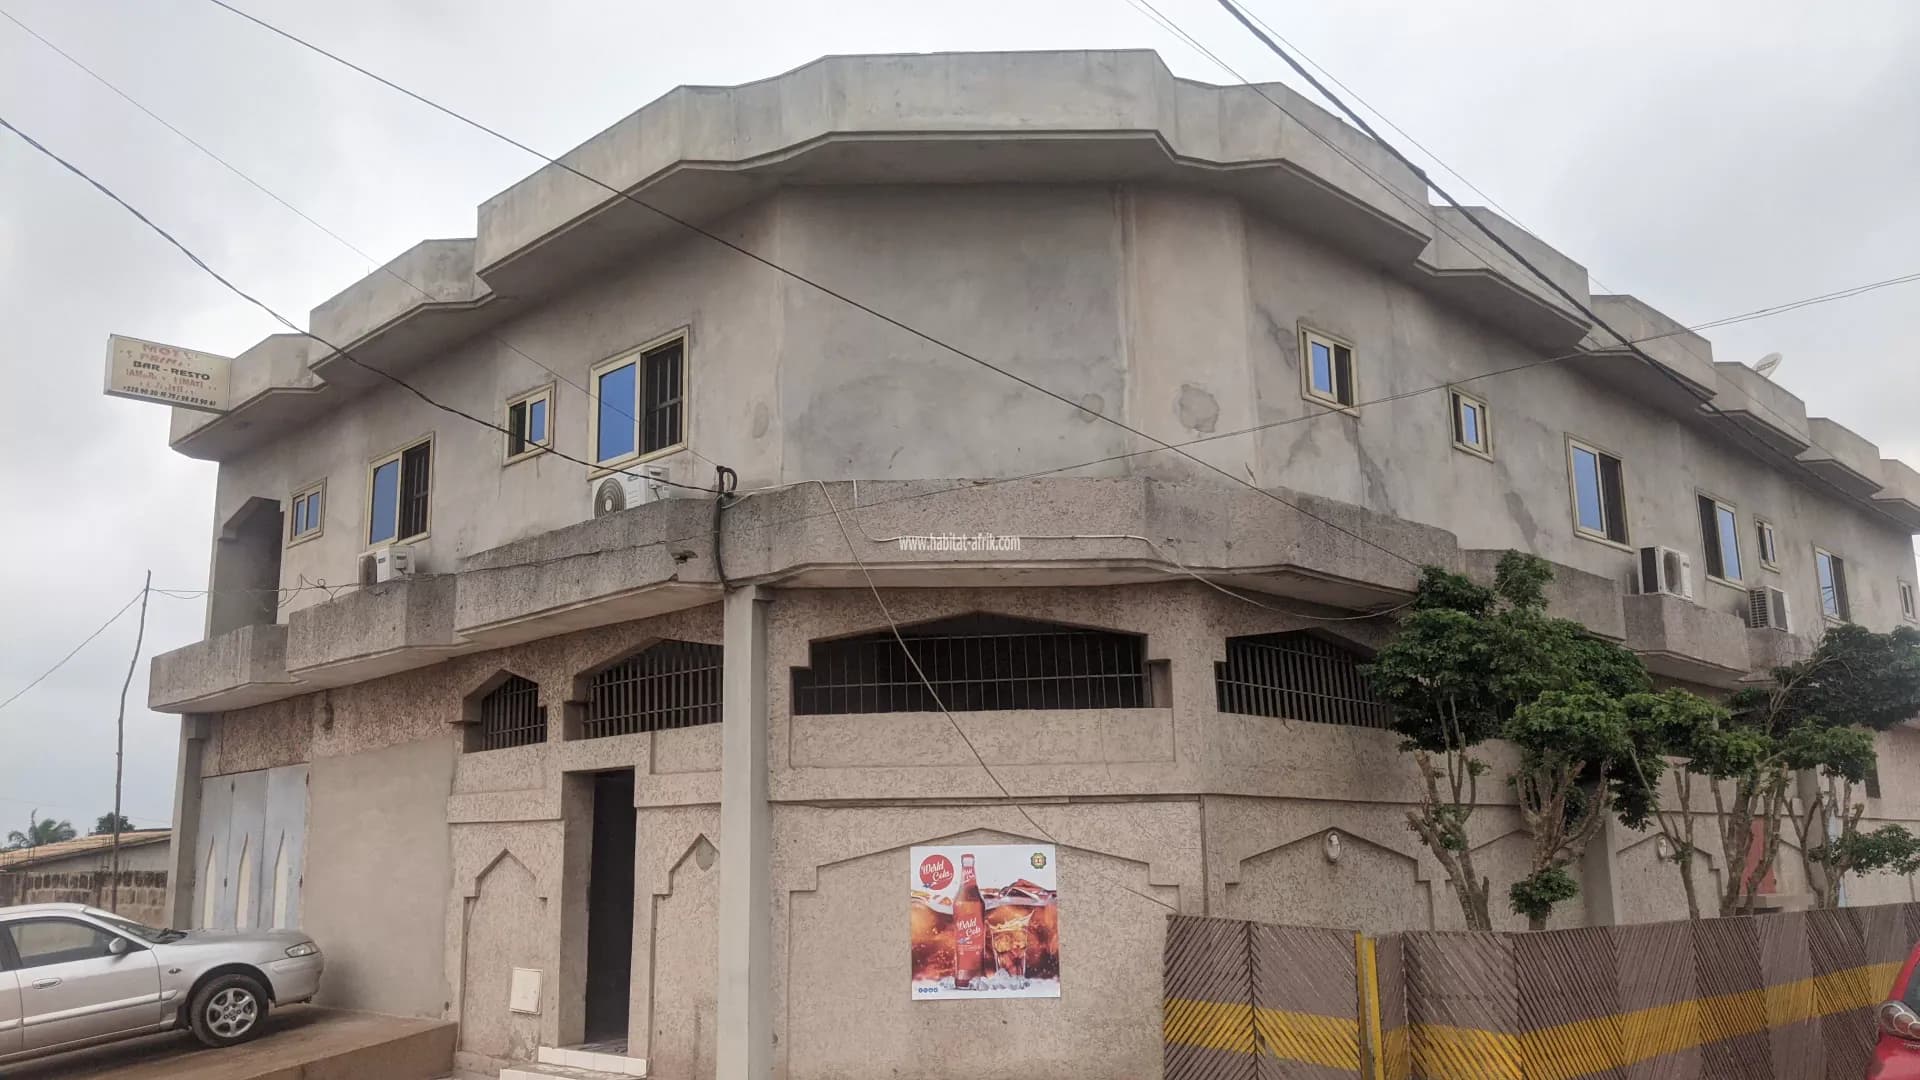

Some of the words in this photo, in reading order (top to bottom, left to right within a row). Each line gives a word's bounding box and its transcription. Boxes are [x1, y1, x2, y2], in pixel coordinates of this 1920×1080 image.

[133, 360, 161, 371] BAR
[171, 367, 210, 381] RESTO
[921, 860, 944, 874] World
[933, 870, 952, 881] Cola
